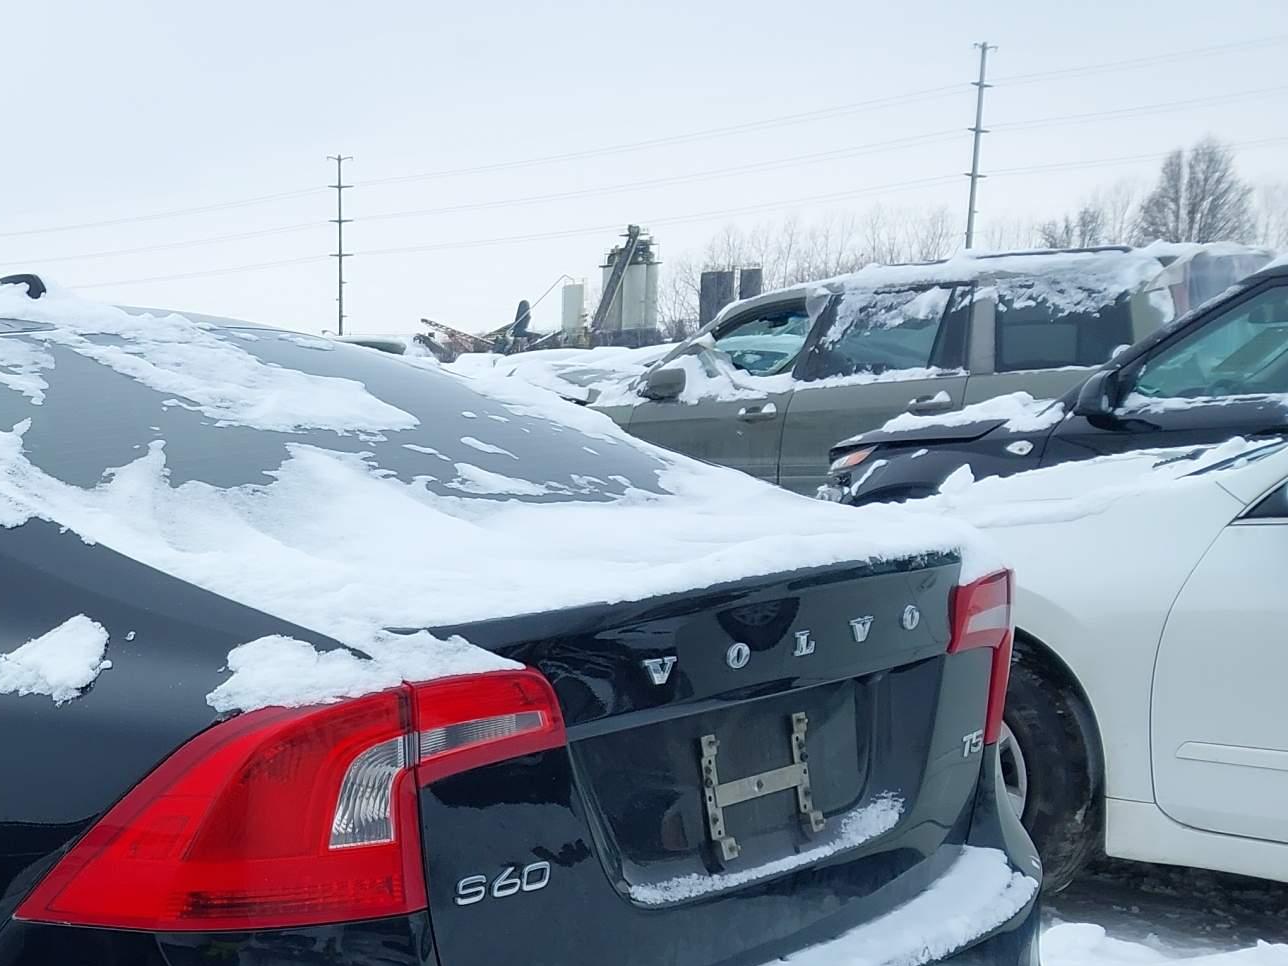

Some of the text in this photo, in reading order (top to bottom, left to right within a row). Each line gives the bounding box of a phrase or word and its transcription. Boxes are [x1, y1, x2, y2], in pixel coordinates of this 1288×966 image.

[643, 604, 920, 685] VOLVO
[962, 729, 983, 758] T5
[454, 861, 551, 906] S60
